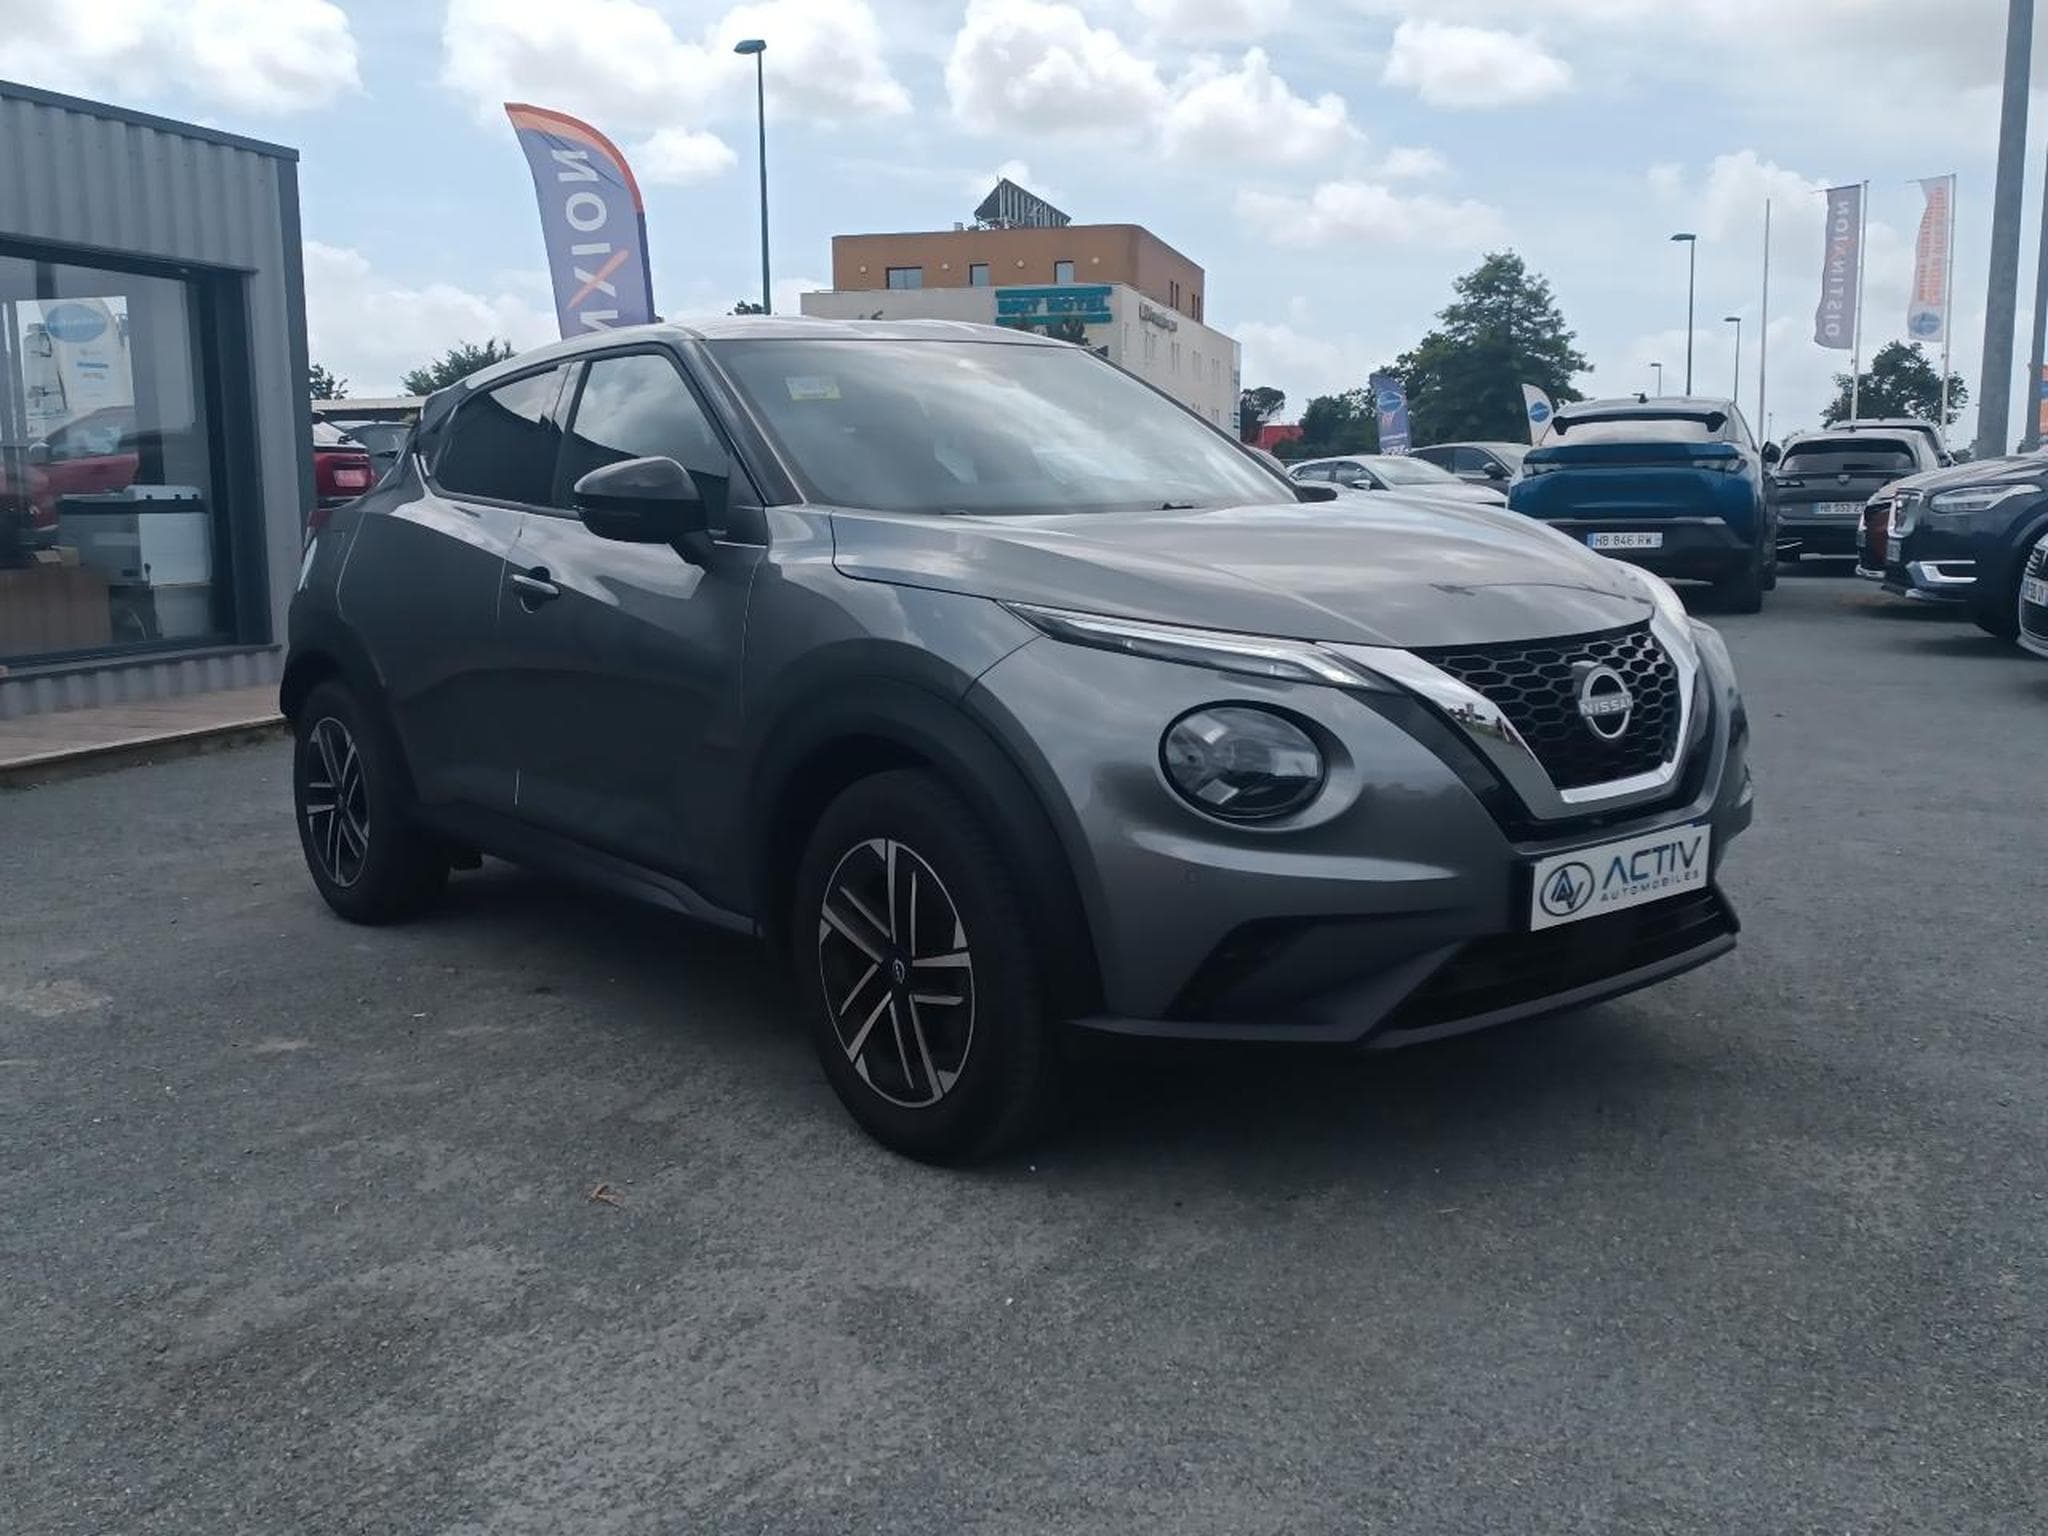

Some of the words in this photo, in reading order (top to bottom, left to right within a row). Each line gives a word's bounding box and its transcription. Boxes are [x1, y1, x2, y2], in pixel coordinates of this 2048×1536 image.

[1580, 697, 1633, 715] NISSAN
[1602, 835, 1702, 890] ACTIV
[1602, 869, 1700, 902] AUTOMOBILES
